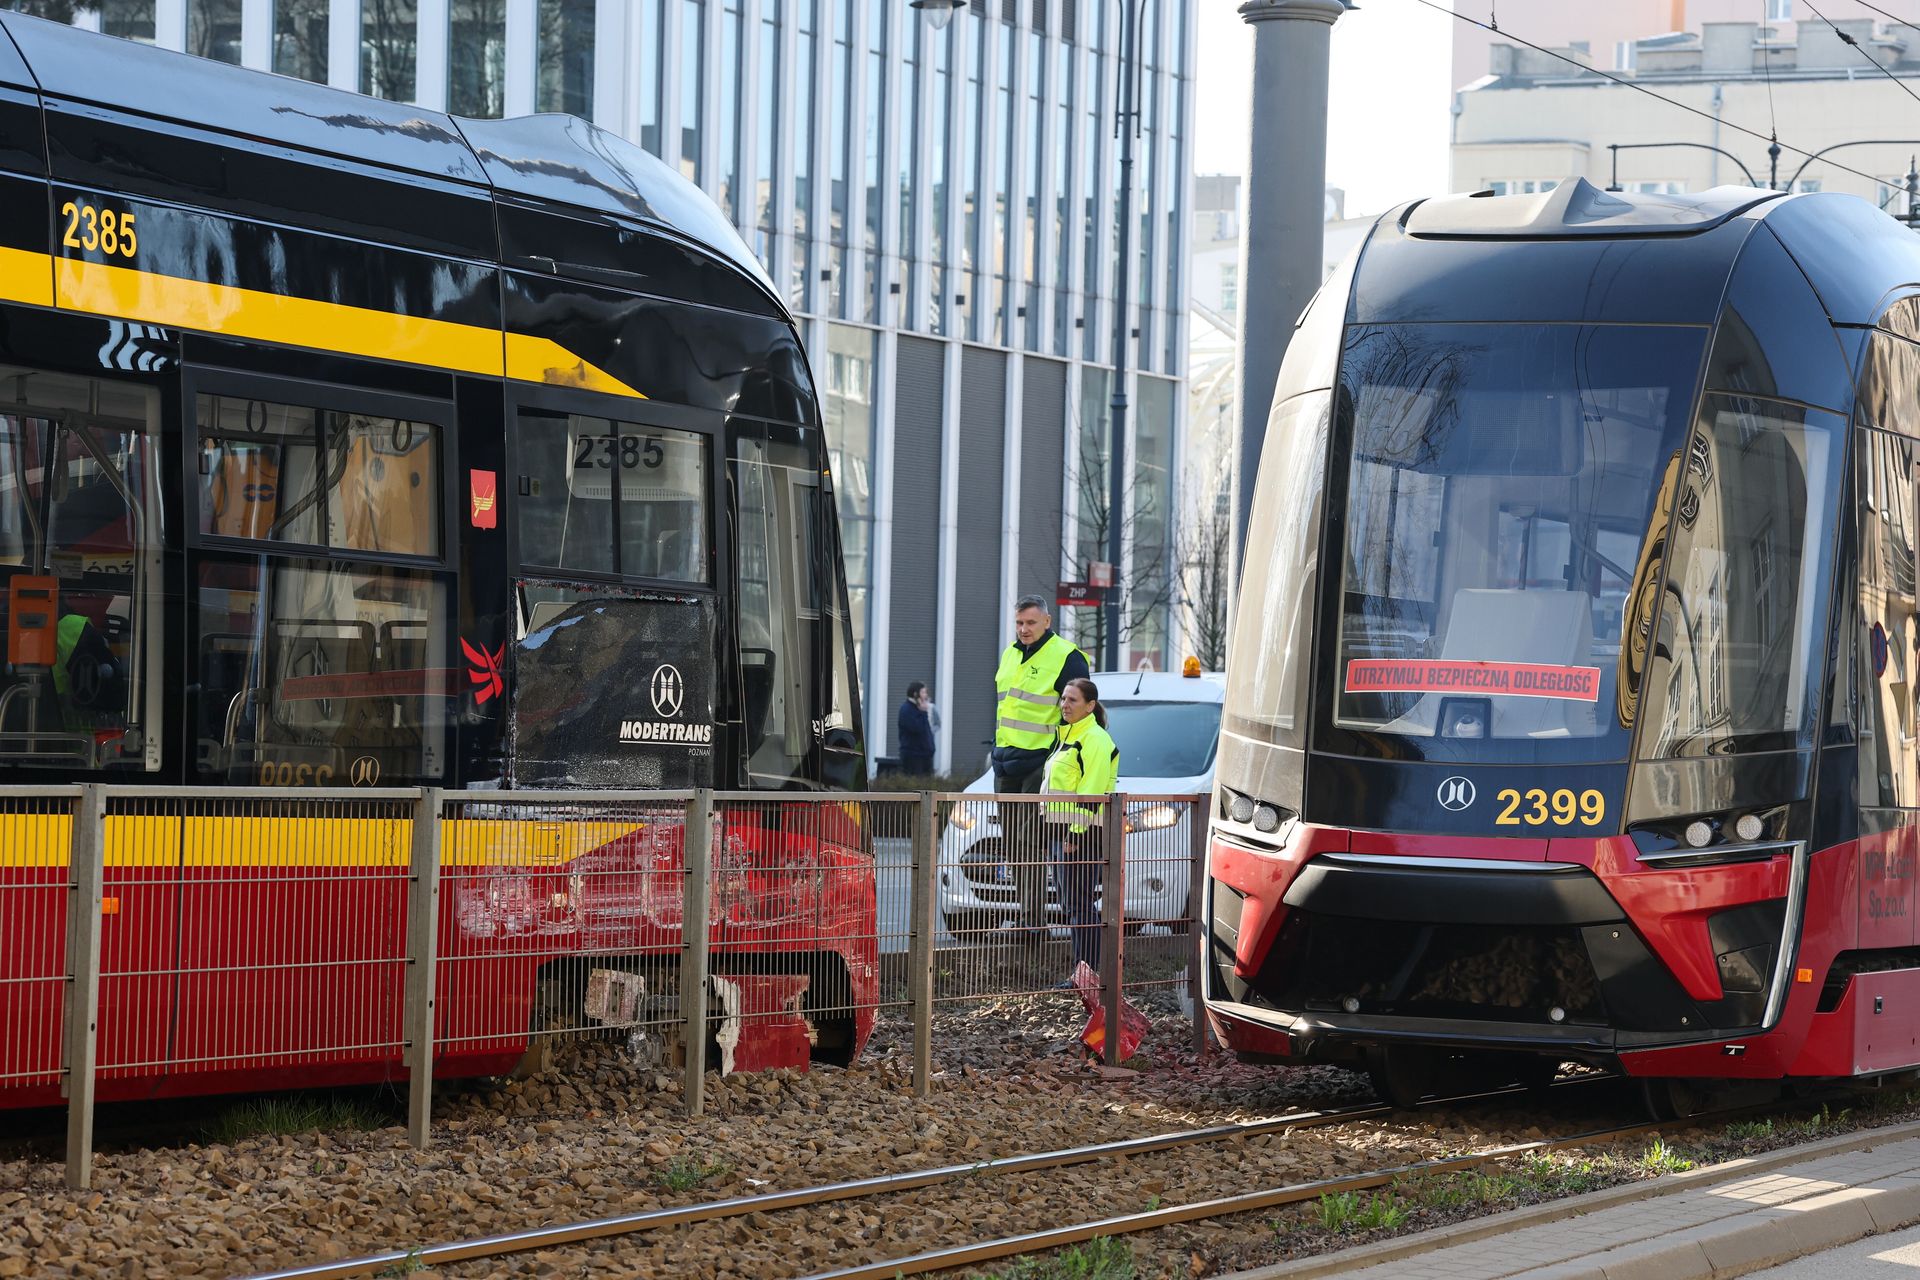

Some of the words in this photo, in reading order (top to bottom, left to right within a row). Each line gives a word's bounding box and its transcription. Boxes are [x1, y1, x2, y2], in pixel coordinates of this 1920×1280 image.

[62, 202, 137, 258] 2385
[574, 434, 664, 469] 2385
[1069, 587, 1087, 598] ZHP
[1353, 667, 1423, 685] UTRZYMUJ
[1427, 668, 1510, 691] BEZPIECZNĄ
[1513, 671, 1592, 693] ODLEGŁOŚĆ
[619, 721, 712, 742] MODERTRANS
[688, 746, 711, 756] POZNAŃ
[1495, 788, 1605, 826] 2399
